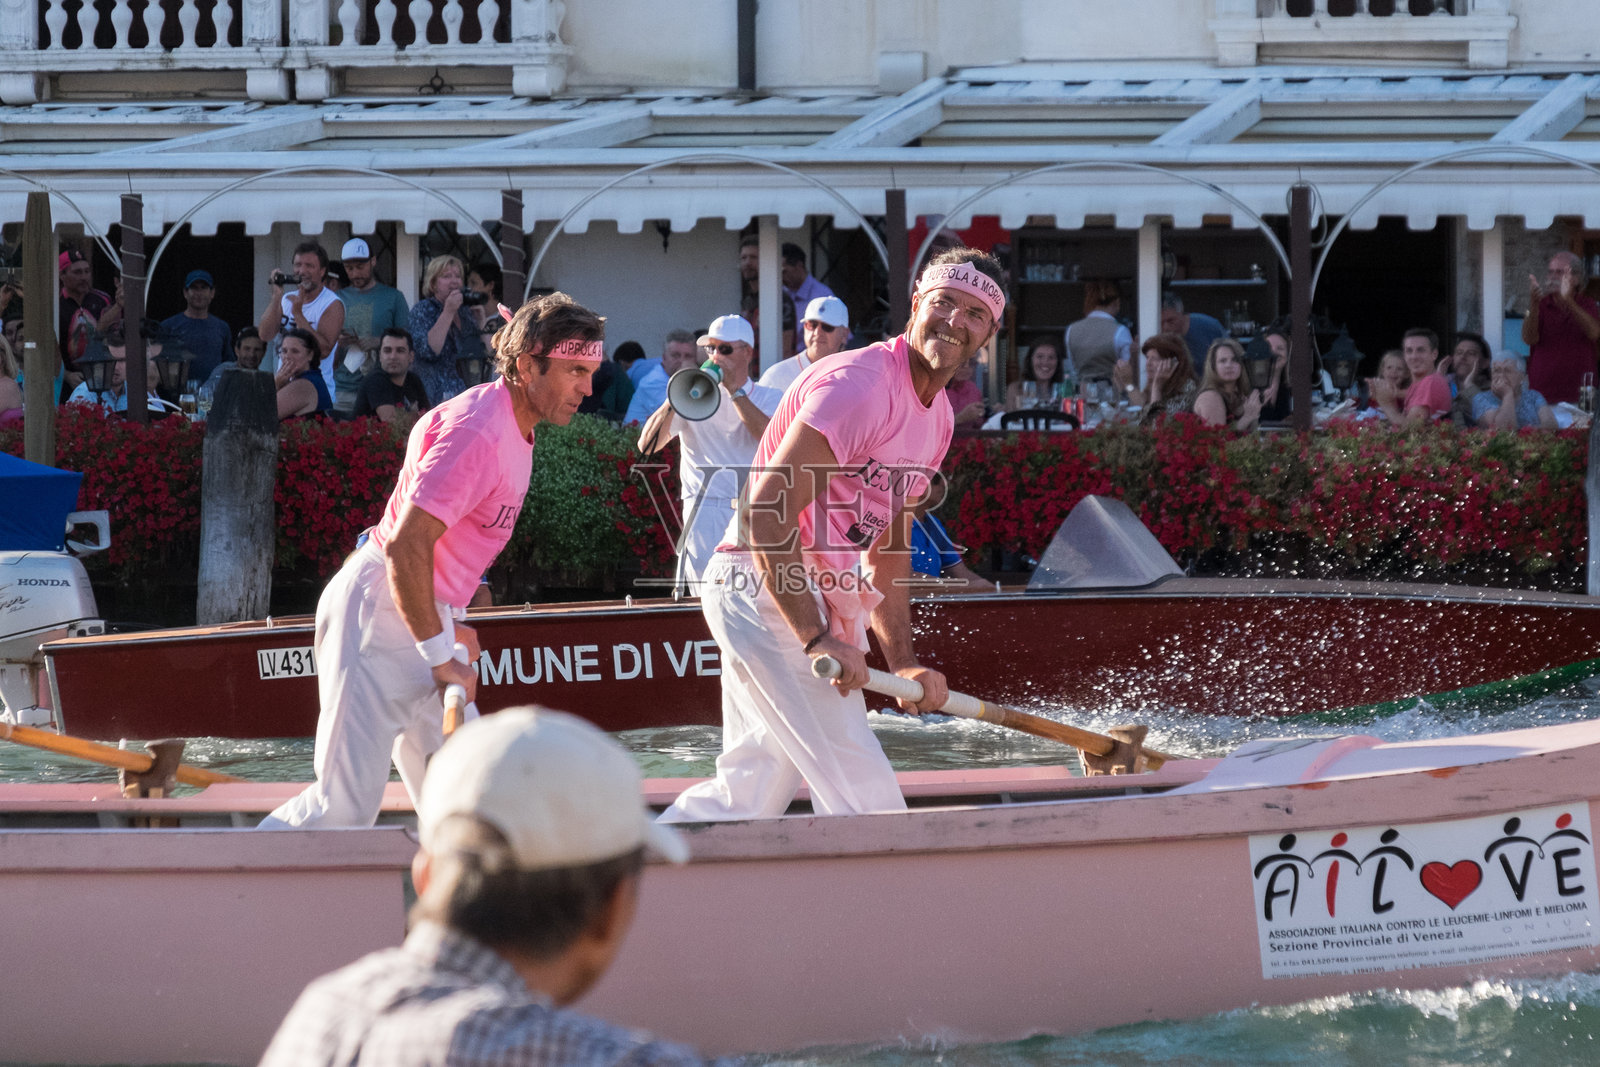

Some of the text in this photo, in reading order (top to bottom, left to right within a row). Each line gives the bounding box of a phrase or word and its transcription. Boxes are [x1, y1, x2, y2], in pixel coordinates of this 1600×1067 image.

[971, 275, 979, 287] &
[554, 341, 597, 357] PUPPOLA
[17, 578, 71, 587] HONDA
[473, 644, 602, 686] MUNE
[612, 642, 653, 680] DI
[1268, 901, 1588, 940] ASSOCIAZIONE ITALIANA CONTRO LE LEUCEMIE-LINFOMI E MIELOMA
[1269, 929, 1463, 953] Sezione Provinciale di Venezia
